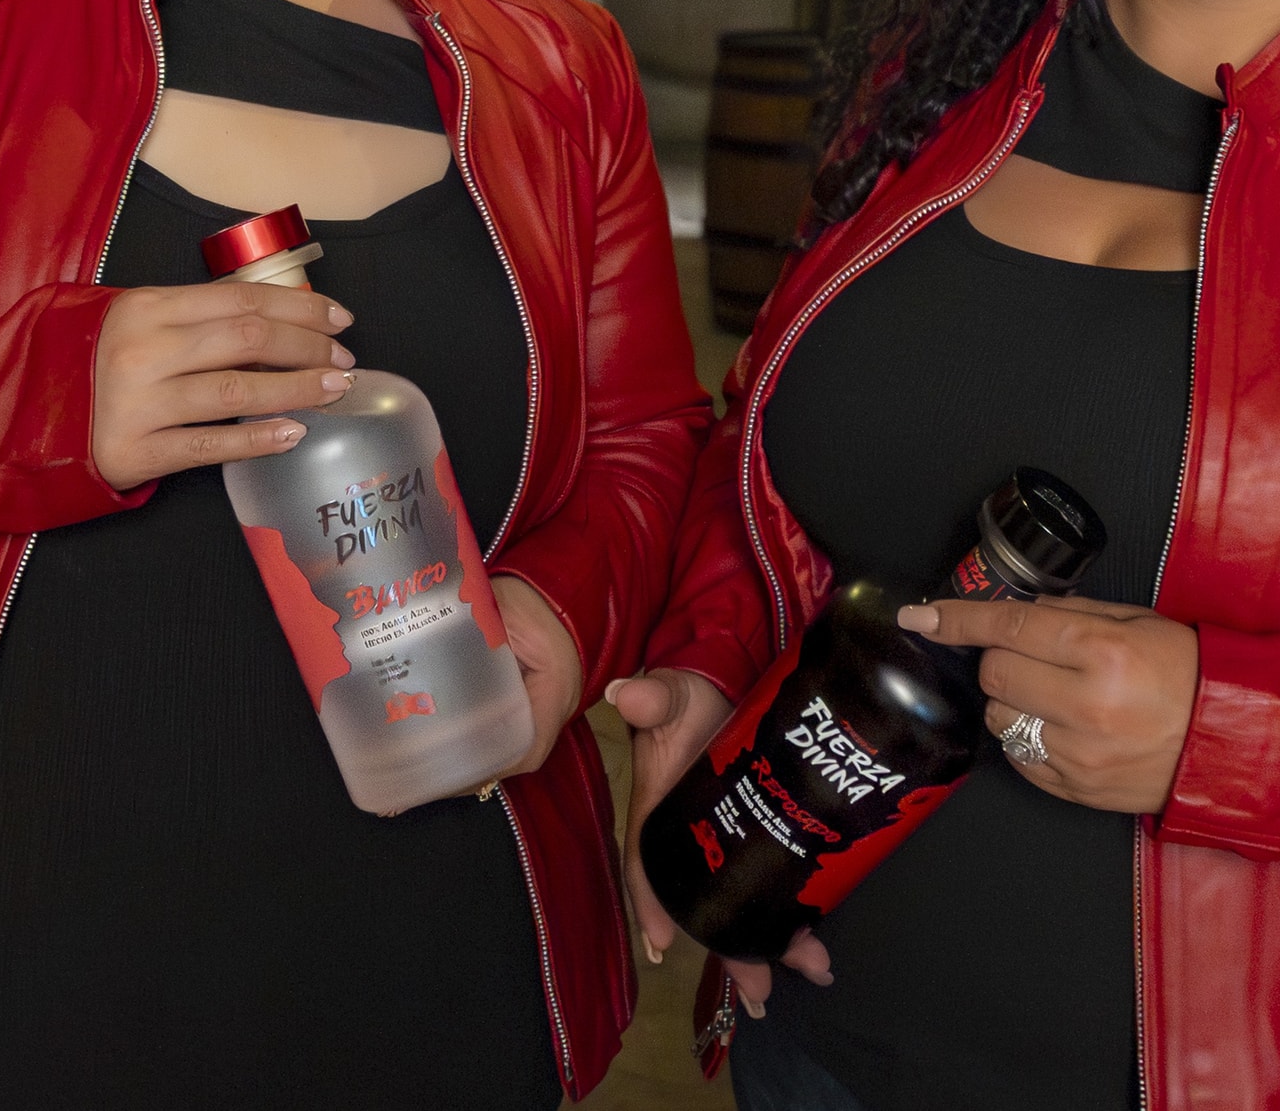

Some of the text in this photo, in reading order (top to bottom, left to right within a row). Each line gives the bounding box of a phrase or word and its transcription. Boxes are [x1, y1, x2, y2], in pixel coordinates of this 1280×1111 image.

[315, 467, 426, 537] FUERZA
[334, 499, 423, 566] DIVINA
[785, 724, 875, 805] DIVINA
[801, 696, 906, 794] FUERZA
[751, 755, 841, 842] REPOSADO
[752, 807, 763, 820] EN
[752, 794, 775, 819] AGAVE
[772, 817, 792, 837] AZUL
